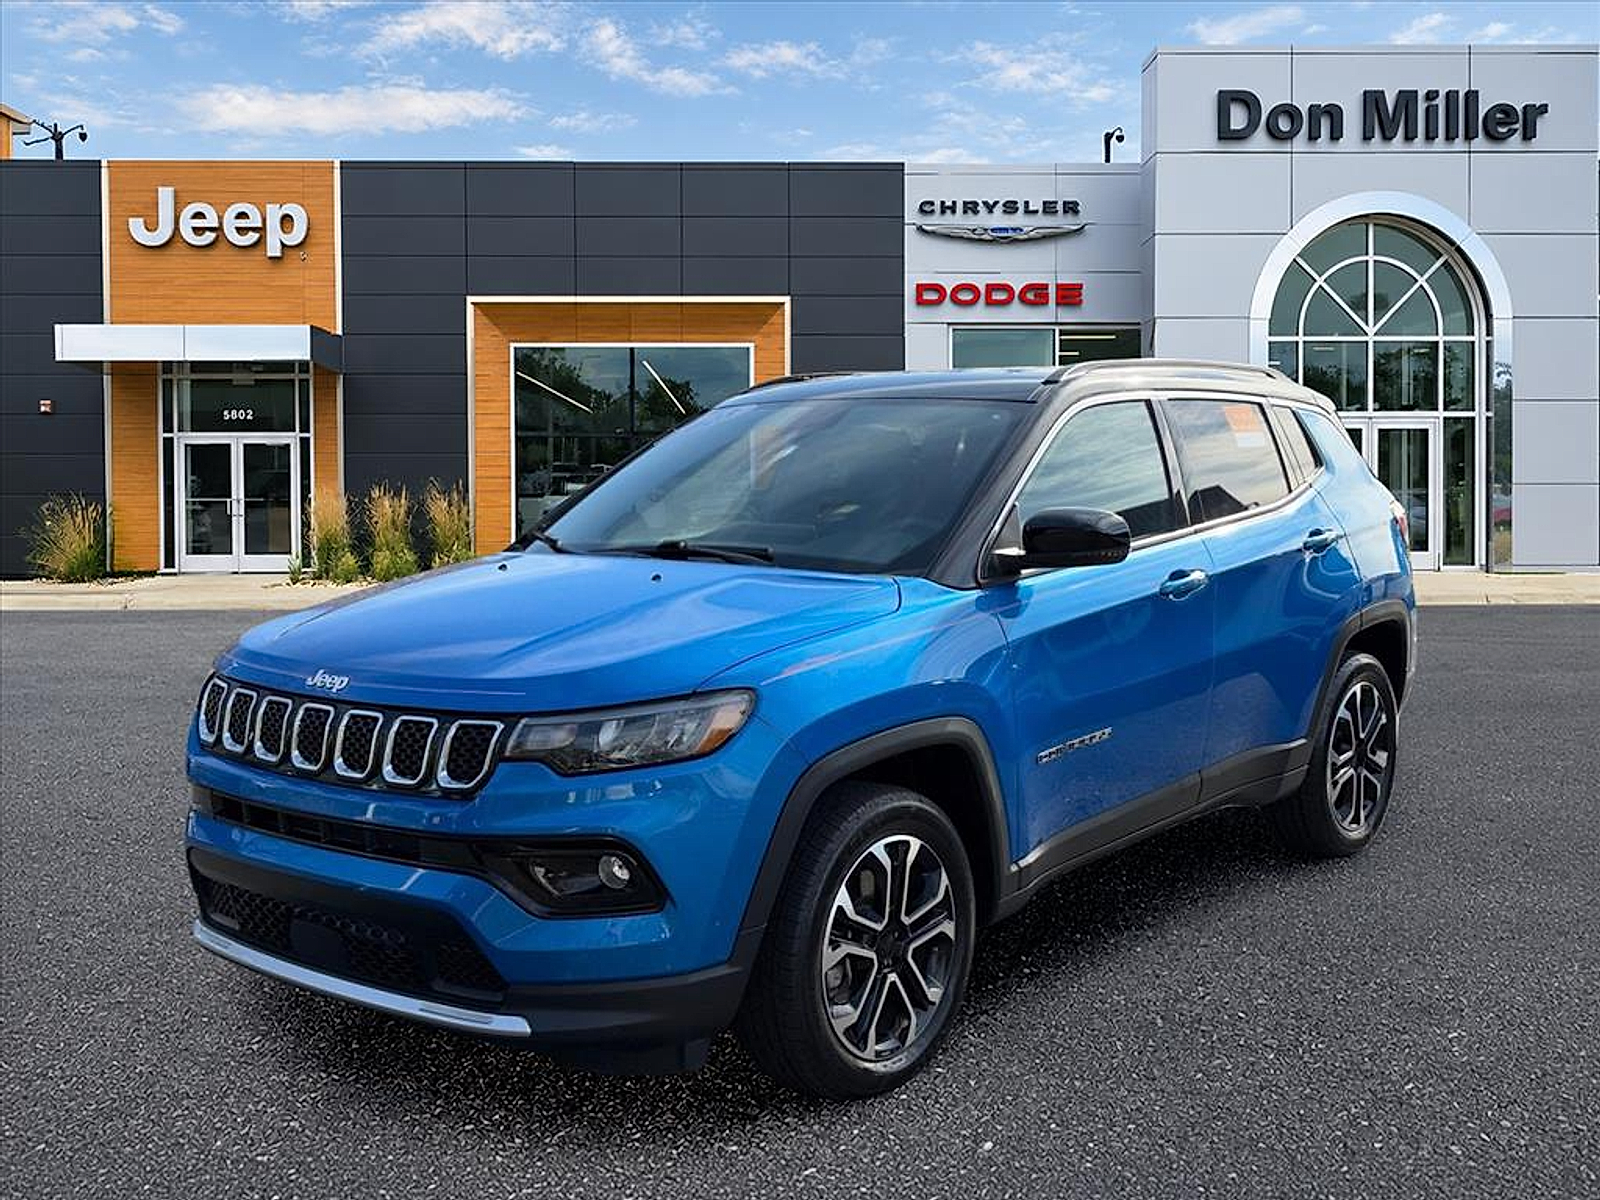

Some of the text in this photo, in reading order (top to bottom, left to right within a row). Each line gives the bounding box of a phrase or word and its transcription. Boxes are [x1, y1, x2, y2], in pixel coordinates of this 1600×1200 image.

[1217, 89, 1549, 141] Don Miller
[918, 199, 1082, 215] CHRYSLER
[128, 186, 309, 258] Jeep
[915, 283, 1084, 306] DODGE
[305, 668, 350, 693] Jeep
